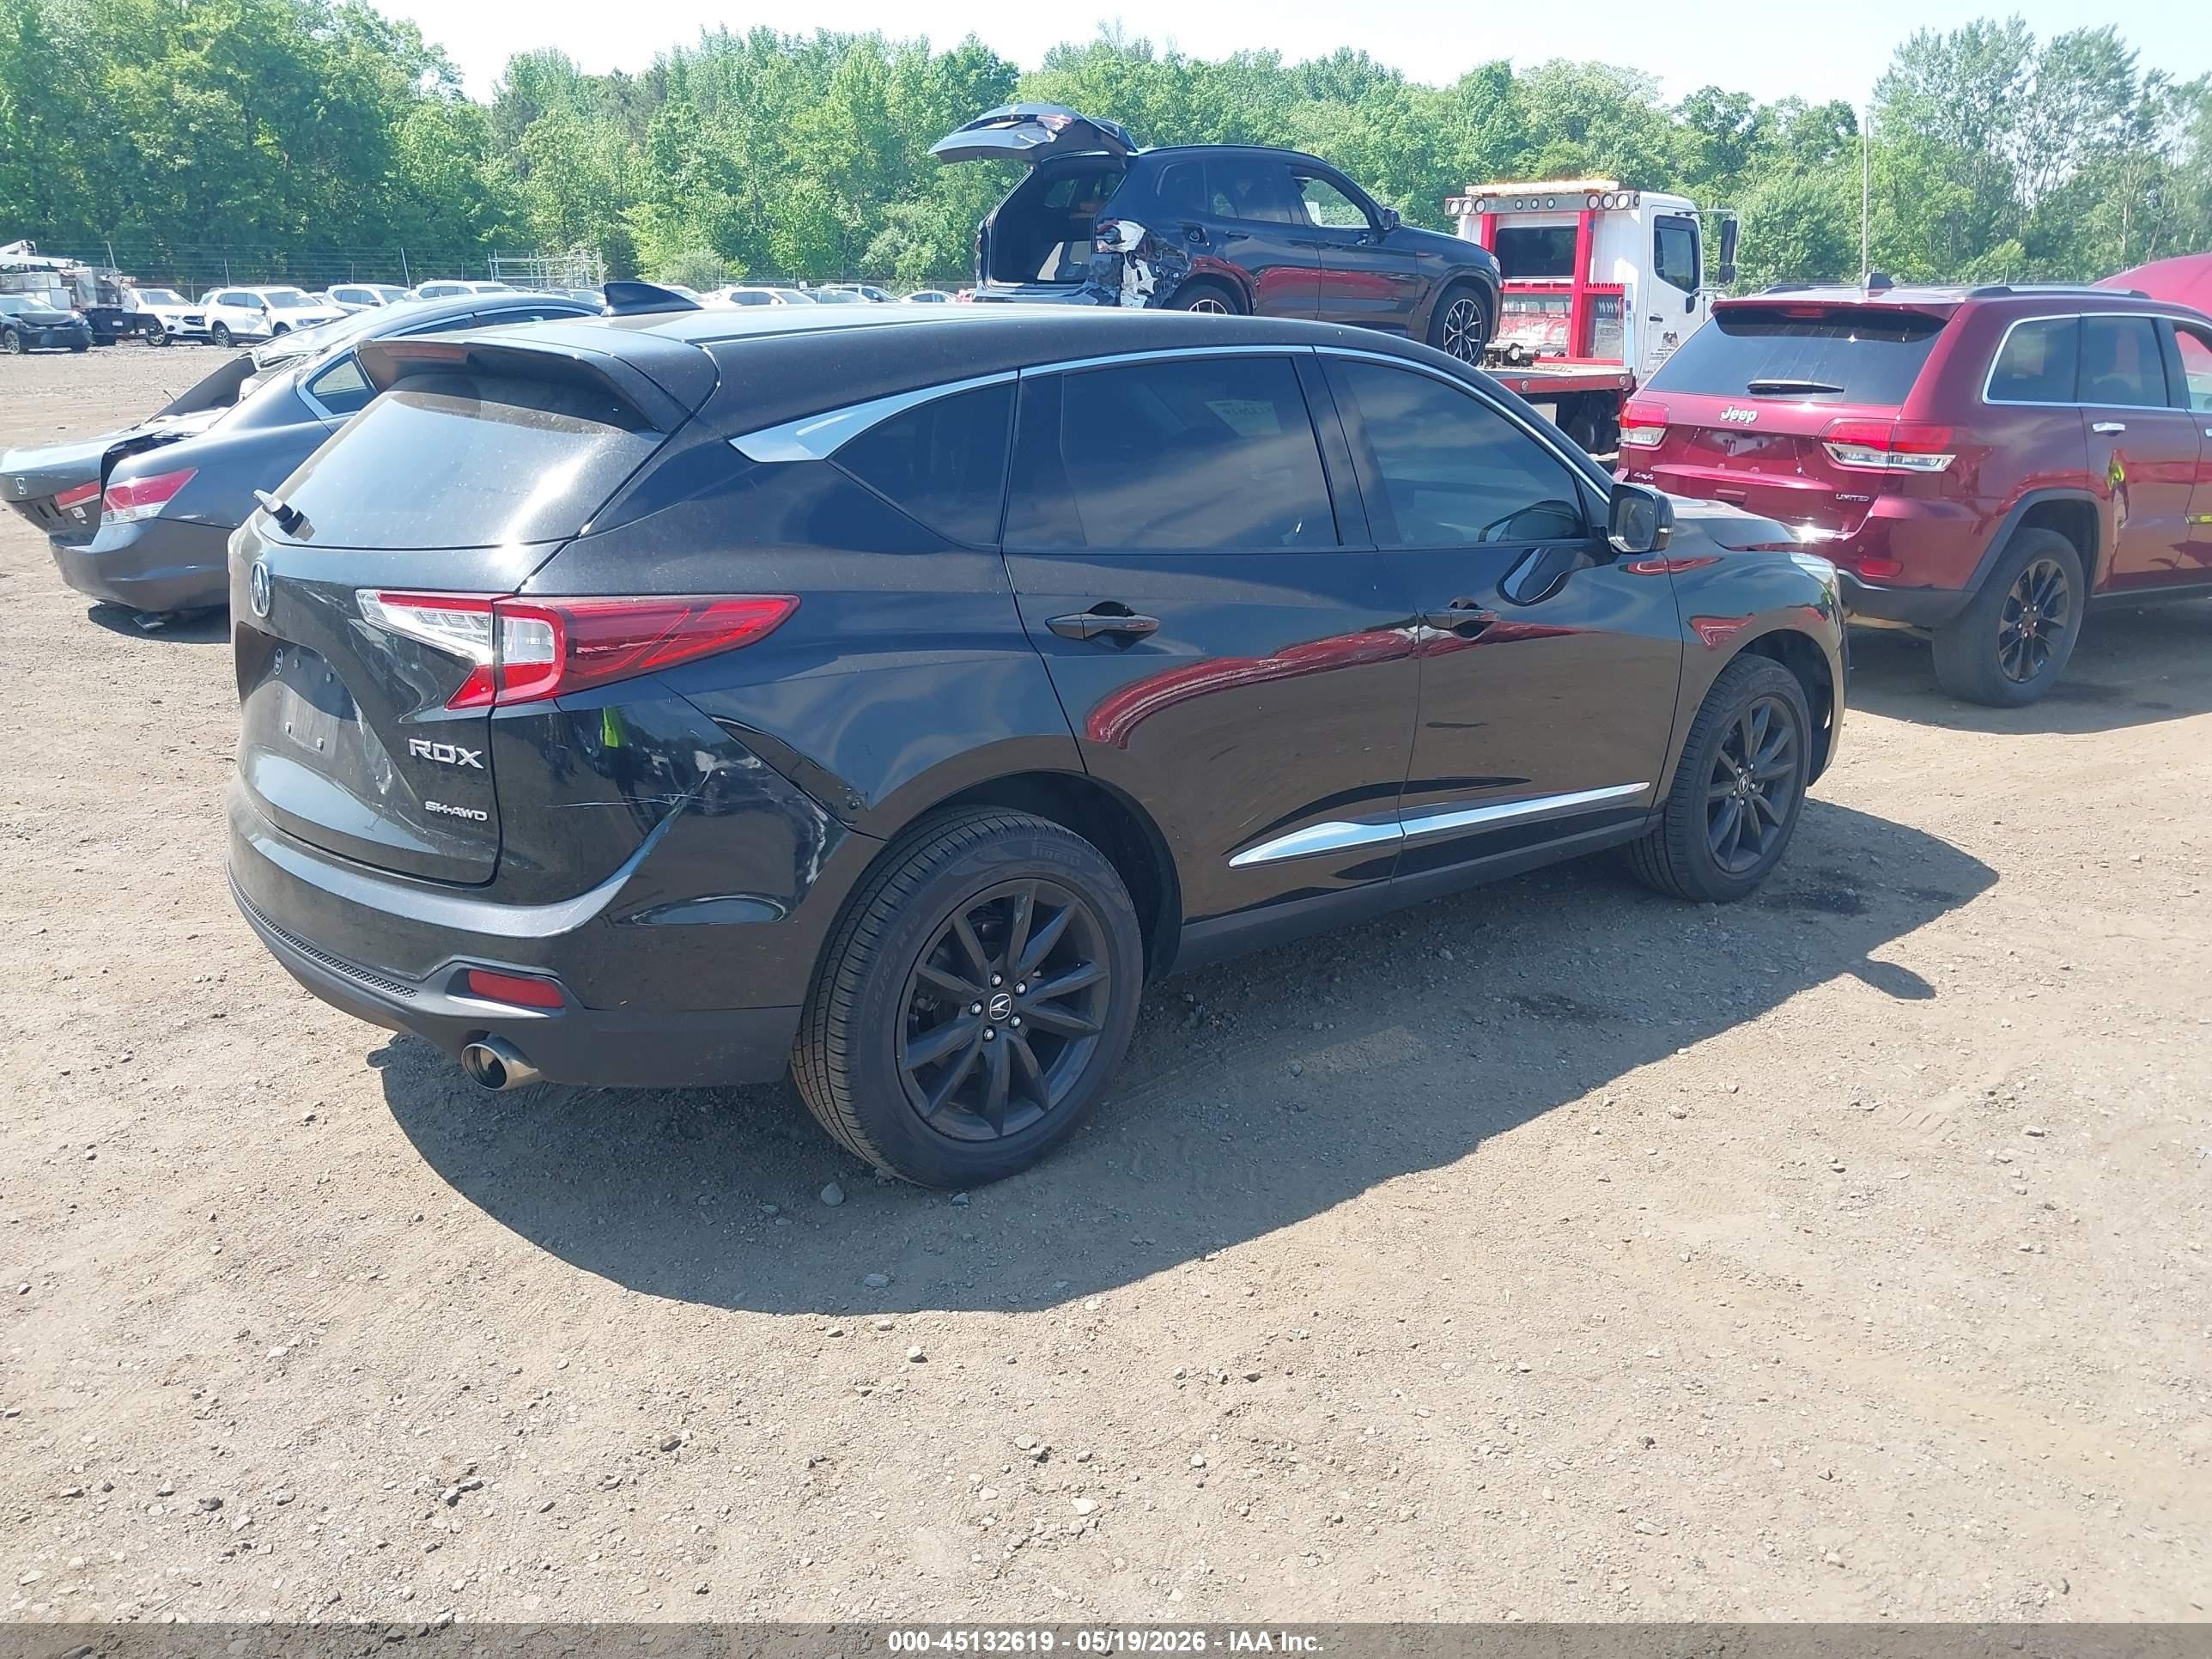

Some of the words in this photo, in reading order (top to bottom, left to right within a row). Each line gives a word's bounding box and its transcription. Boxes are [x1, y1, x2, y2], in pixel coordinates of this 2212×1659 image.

[1720, 405, 1759, 424] Jeep
[1835, 494, 1869, 502] LIMITED
[409, 738, 484, 769] RDX
[425, 800, 488, 821] SH-AWD
